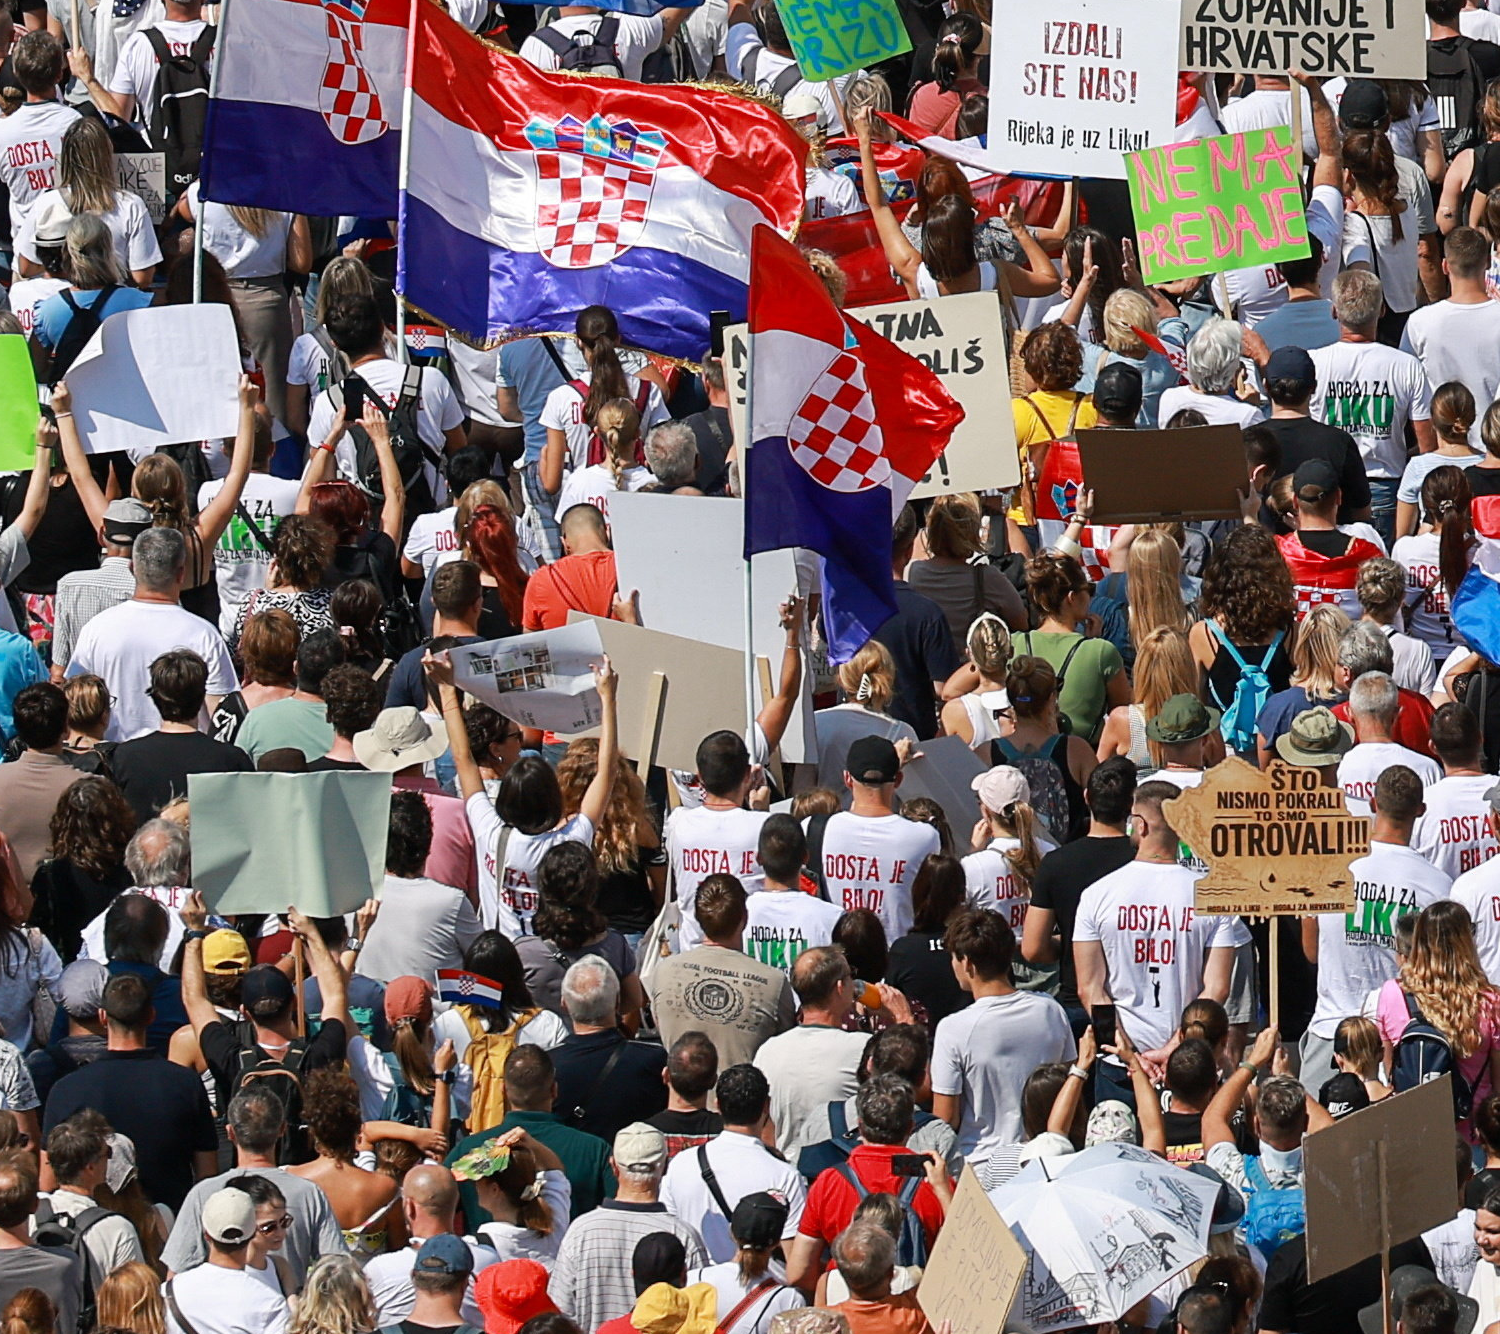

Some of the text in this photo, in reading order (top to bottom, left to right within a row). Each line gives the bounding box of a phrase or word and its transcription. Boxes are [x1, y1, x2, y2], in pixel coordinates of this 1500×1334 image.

[1043, 20, 1122, 59] IZDALI
[1185, 25, 1376, 74] HRVATSKE
[1022, 61, 1138, 105] STE NAS!
[1007, 118, 1150, 153] Rijeka je uz Liku!
[1130, 131, 1294, 213] NEMA
[1138, 187, 1306, 277] PREDAJE
[1272, 764, 1316, 792] ŠTO
[1217, 791, 1344, 810] NISMO POKRALI
[1254, 809, 1306, 821] TO SMO
[1211, 817, 1369, 859] OTROVALI!!!
[826, 854, 880, 883] DOSTA
[842, 888, 885, 915] BILO!
[1116, 904, 1195, 932] DOSTA JE
